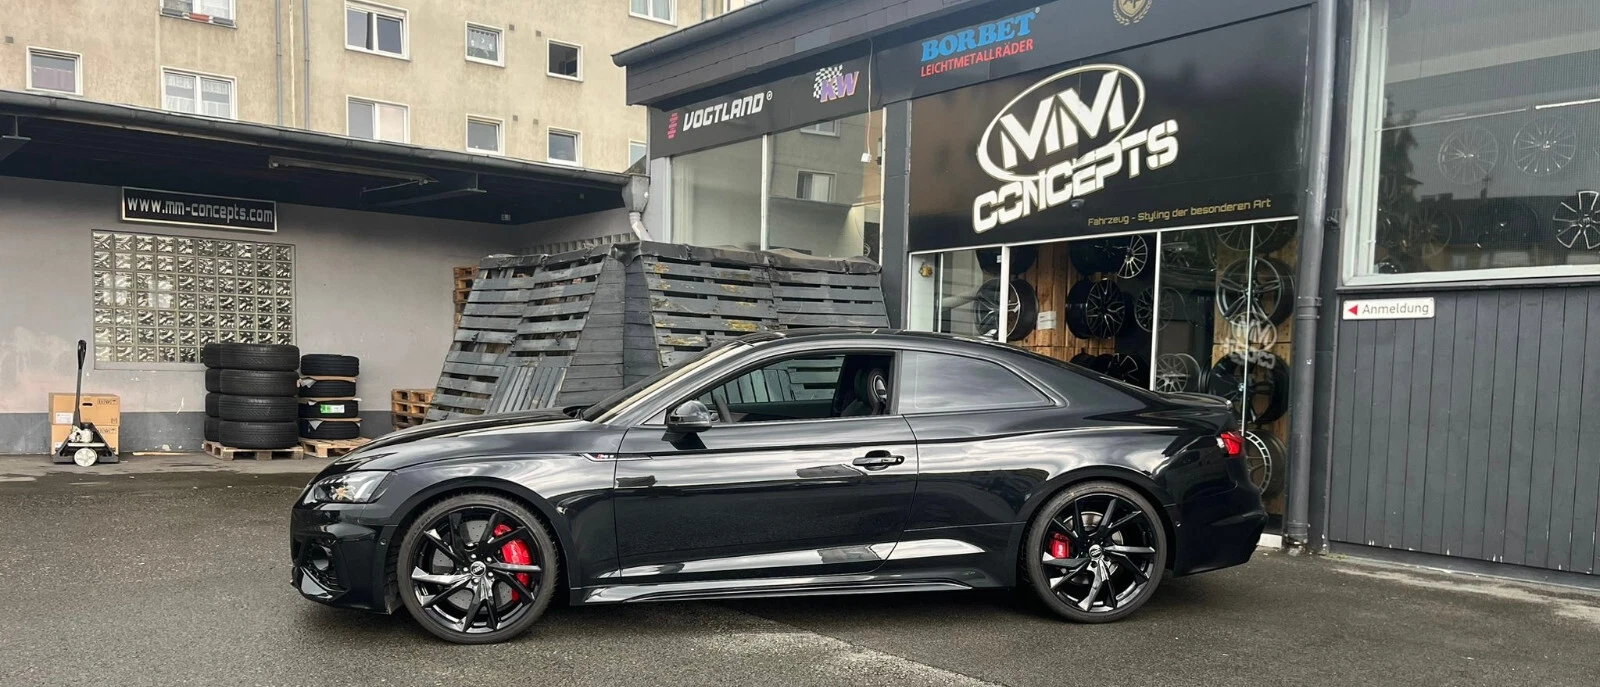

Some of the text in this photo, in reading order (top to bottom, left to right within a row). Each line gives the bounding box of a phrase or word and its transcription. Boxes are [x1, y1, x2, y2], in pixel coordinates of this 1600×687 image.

[921, 11, 1036, 62] BORBET
[920, 38, 1034, 77] LEICHTMETALLRÄDER
[819, 70, 860, 103] KW
[682, 92, 765, 132] VOGTLAND
[999, 69, 1126, 170] MM
[972, 118, 1179, 234] CONCEPTS
[127, 197, 273, 223] www.mm-concepts.com
[1087, 215, 1130, 226] Fahrzeug
[1138, 210, 1170, 223] Styling
[1172, 207, 1189, 218] der
[1190, 202, 1251, 216] besonderen
[1253, 198, 1272, 208] Art
[1362, 303, 1429, 315] Anmeldung
